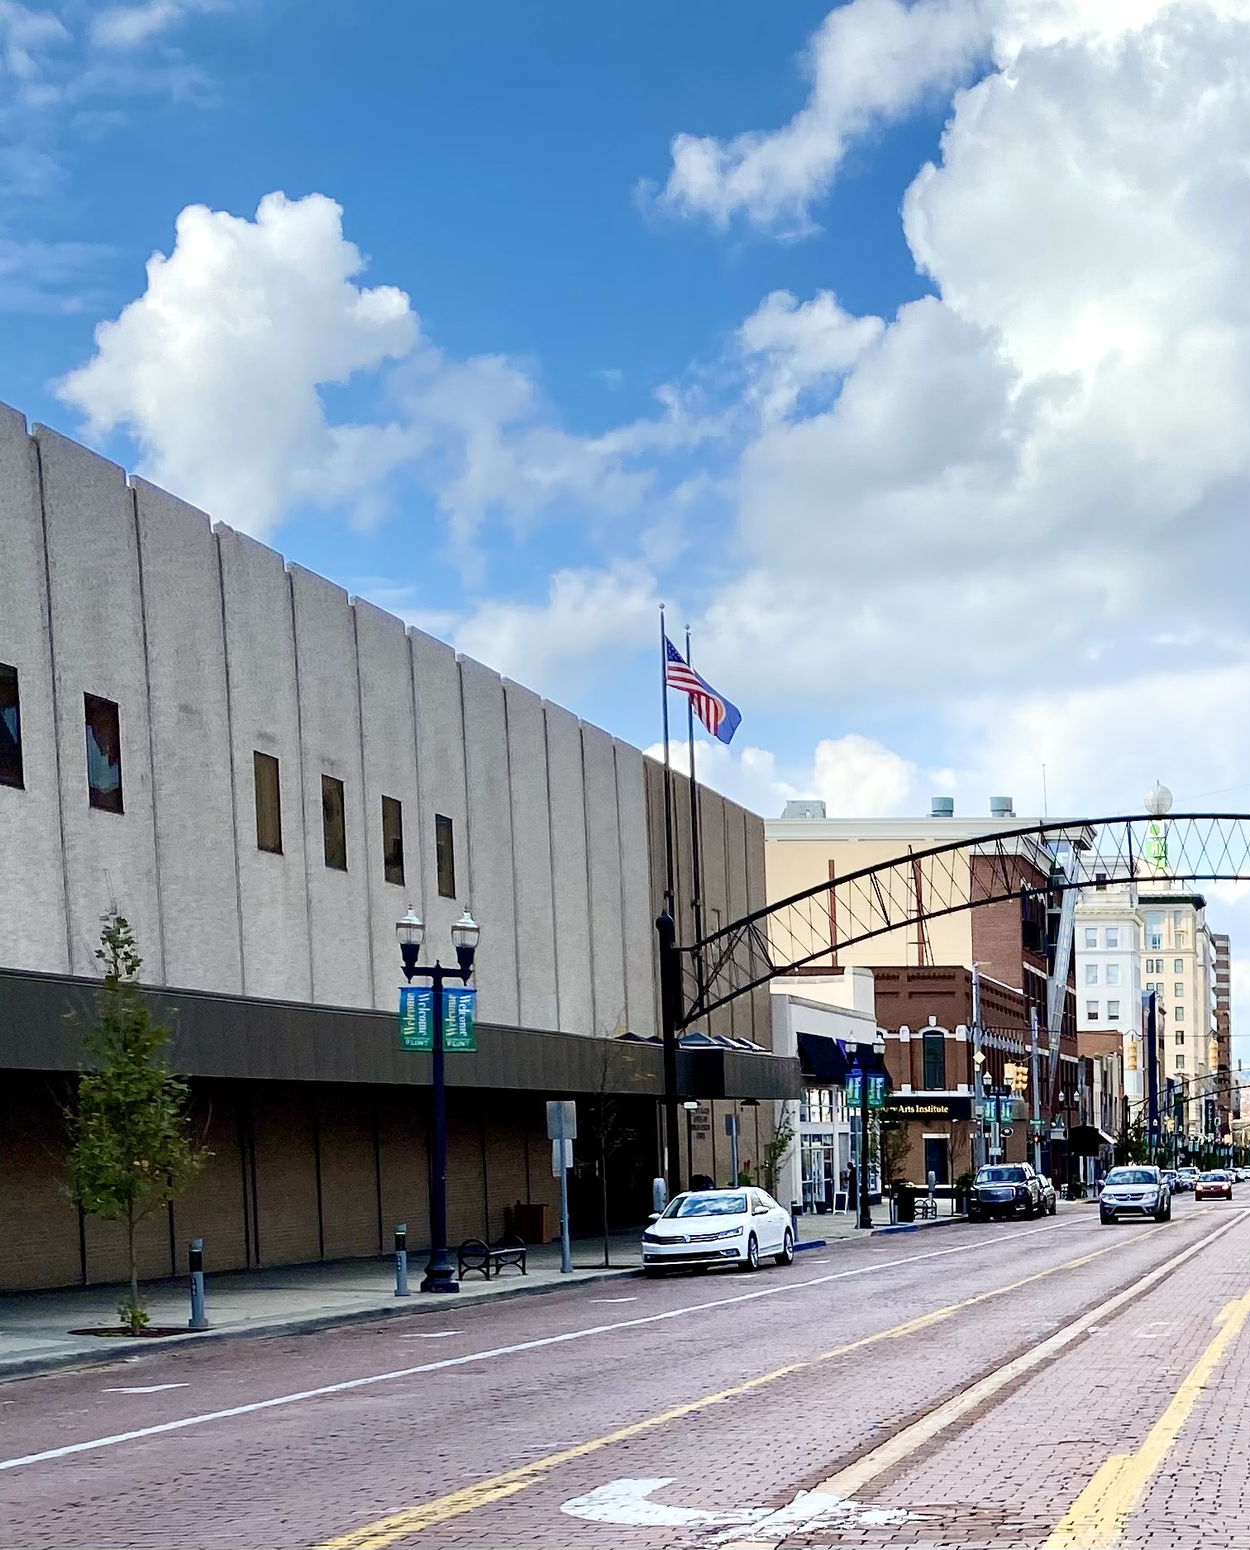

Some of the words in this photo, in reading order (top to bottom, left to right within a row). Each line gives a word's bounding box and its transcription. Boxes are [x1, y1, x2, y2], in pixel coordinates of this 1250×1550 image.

[403, 992, 416, 1035] Welcome
[418, 993, 431, 1036] Welcome
[445, 994, 458, 1036] Welcome
[458, 994, 471, 1036] Welcome
[898, 1105, 914, 1113] Arts
[916, 1104, 949, 1113] Institute
